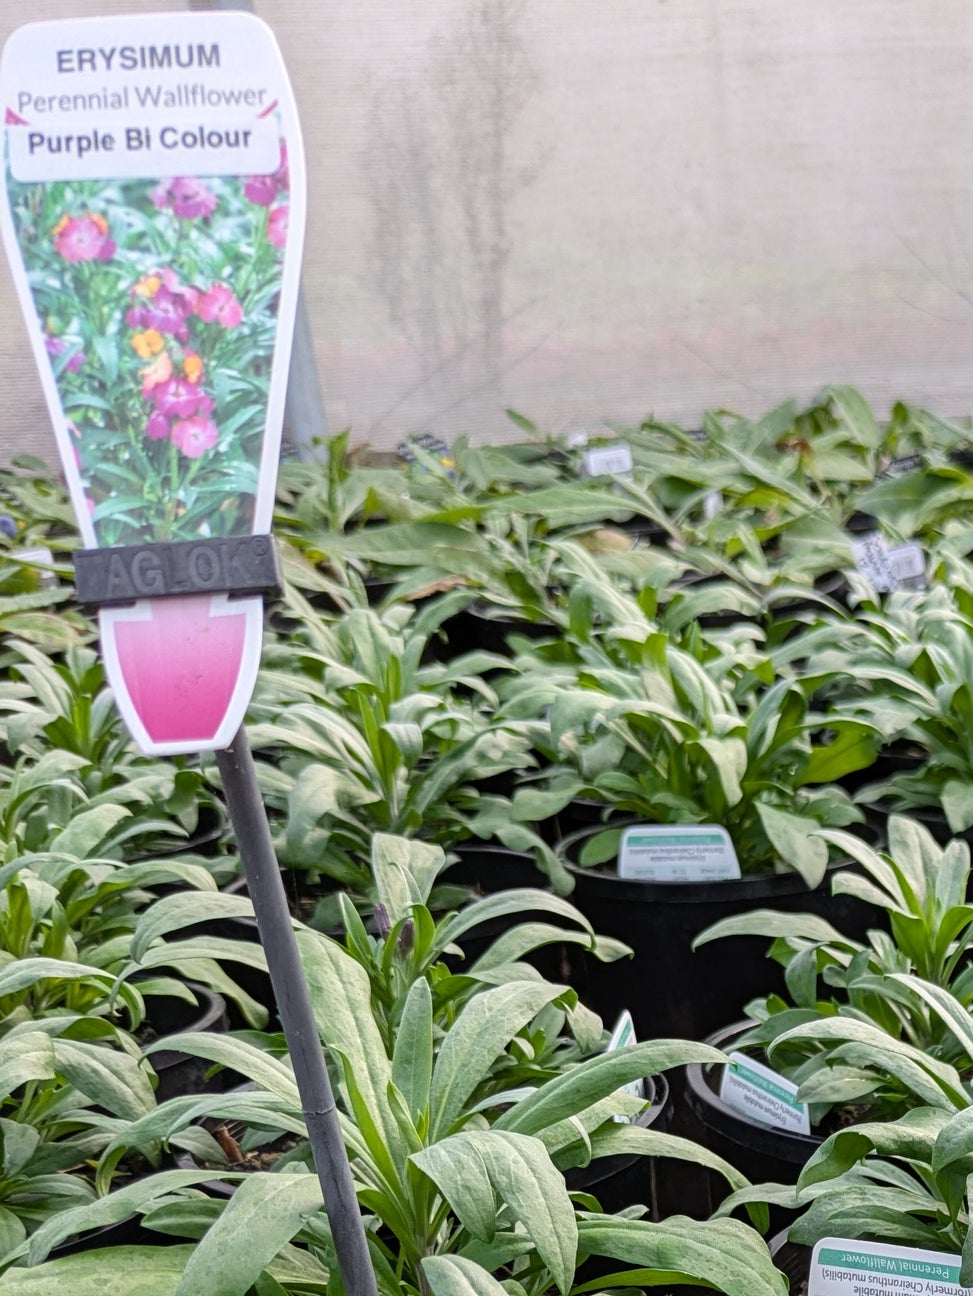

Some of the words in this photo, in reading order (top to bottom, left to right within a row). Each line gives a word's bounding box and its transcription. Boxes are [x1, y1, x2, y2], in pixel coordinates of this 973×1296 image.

[56, 44, 220, 73] ERYSIMUM
[18, 86, 129, 114] Perennial
[135, 84, 267, 108] Wallflower
[28, 130, 115, 158] Purple
[126, 128, 151, 150] Bi
[160, 126, 251, 150] Colour
[840, 1254, 895, 1270] Wallflower
[899, 1262, 949, 1278] Perennial
[822, 1268, 866, 1283] mutabilis)
[868, 1275, 923, 1292] Cheiranthus
